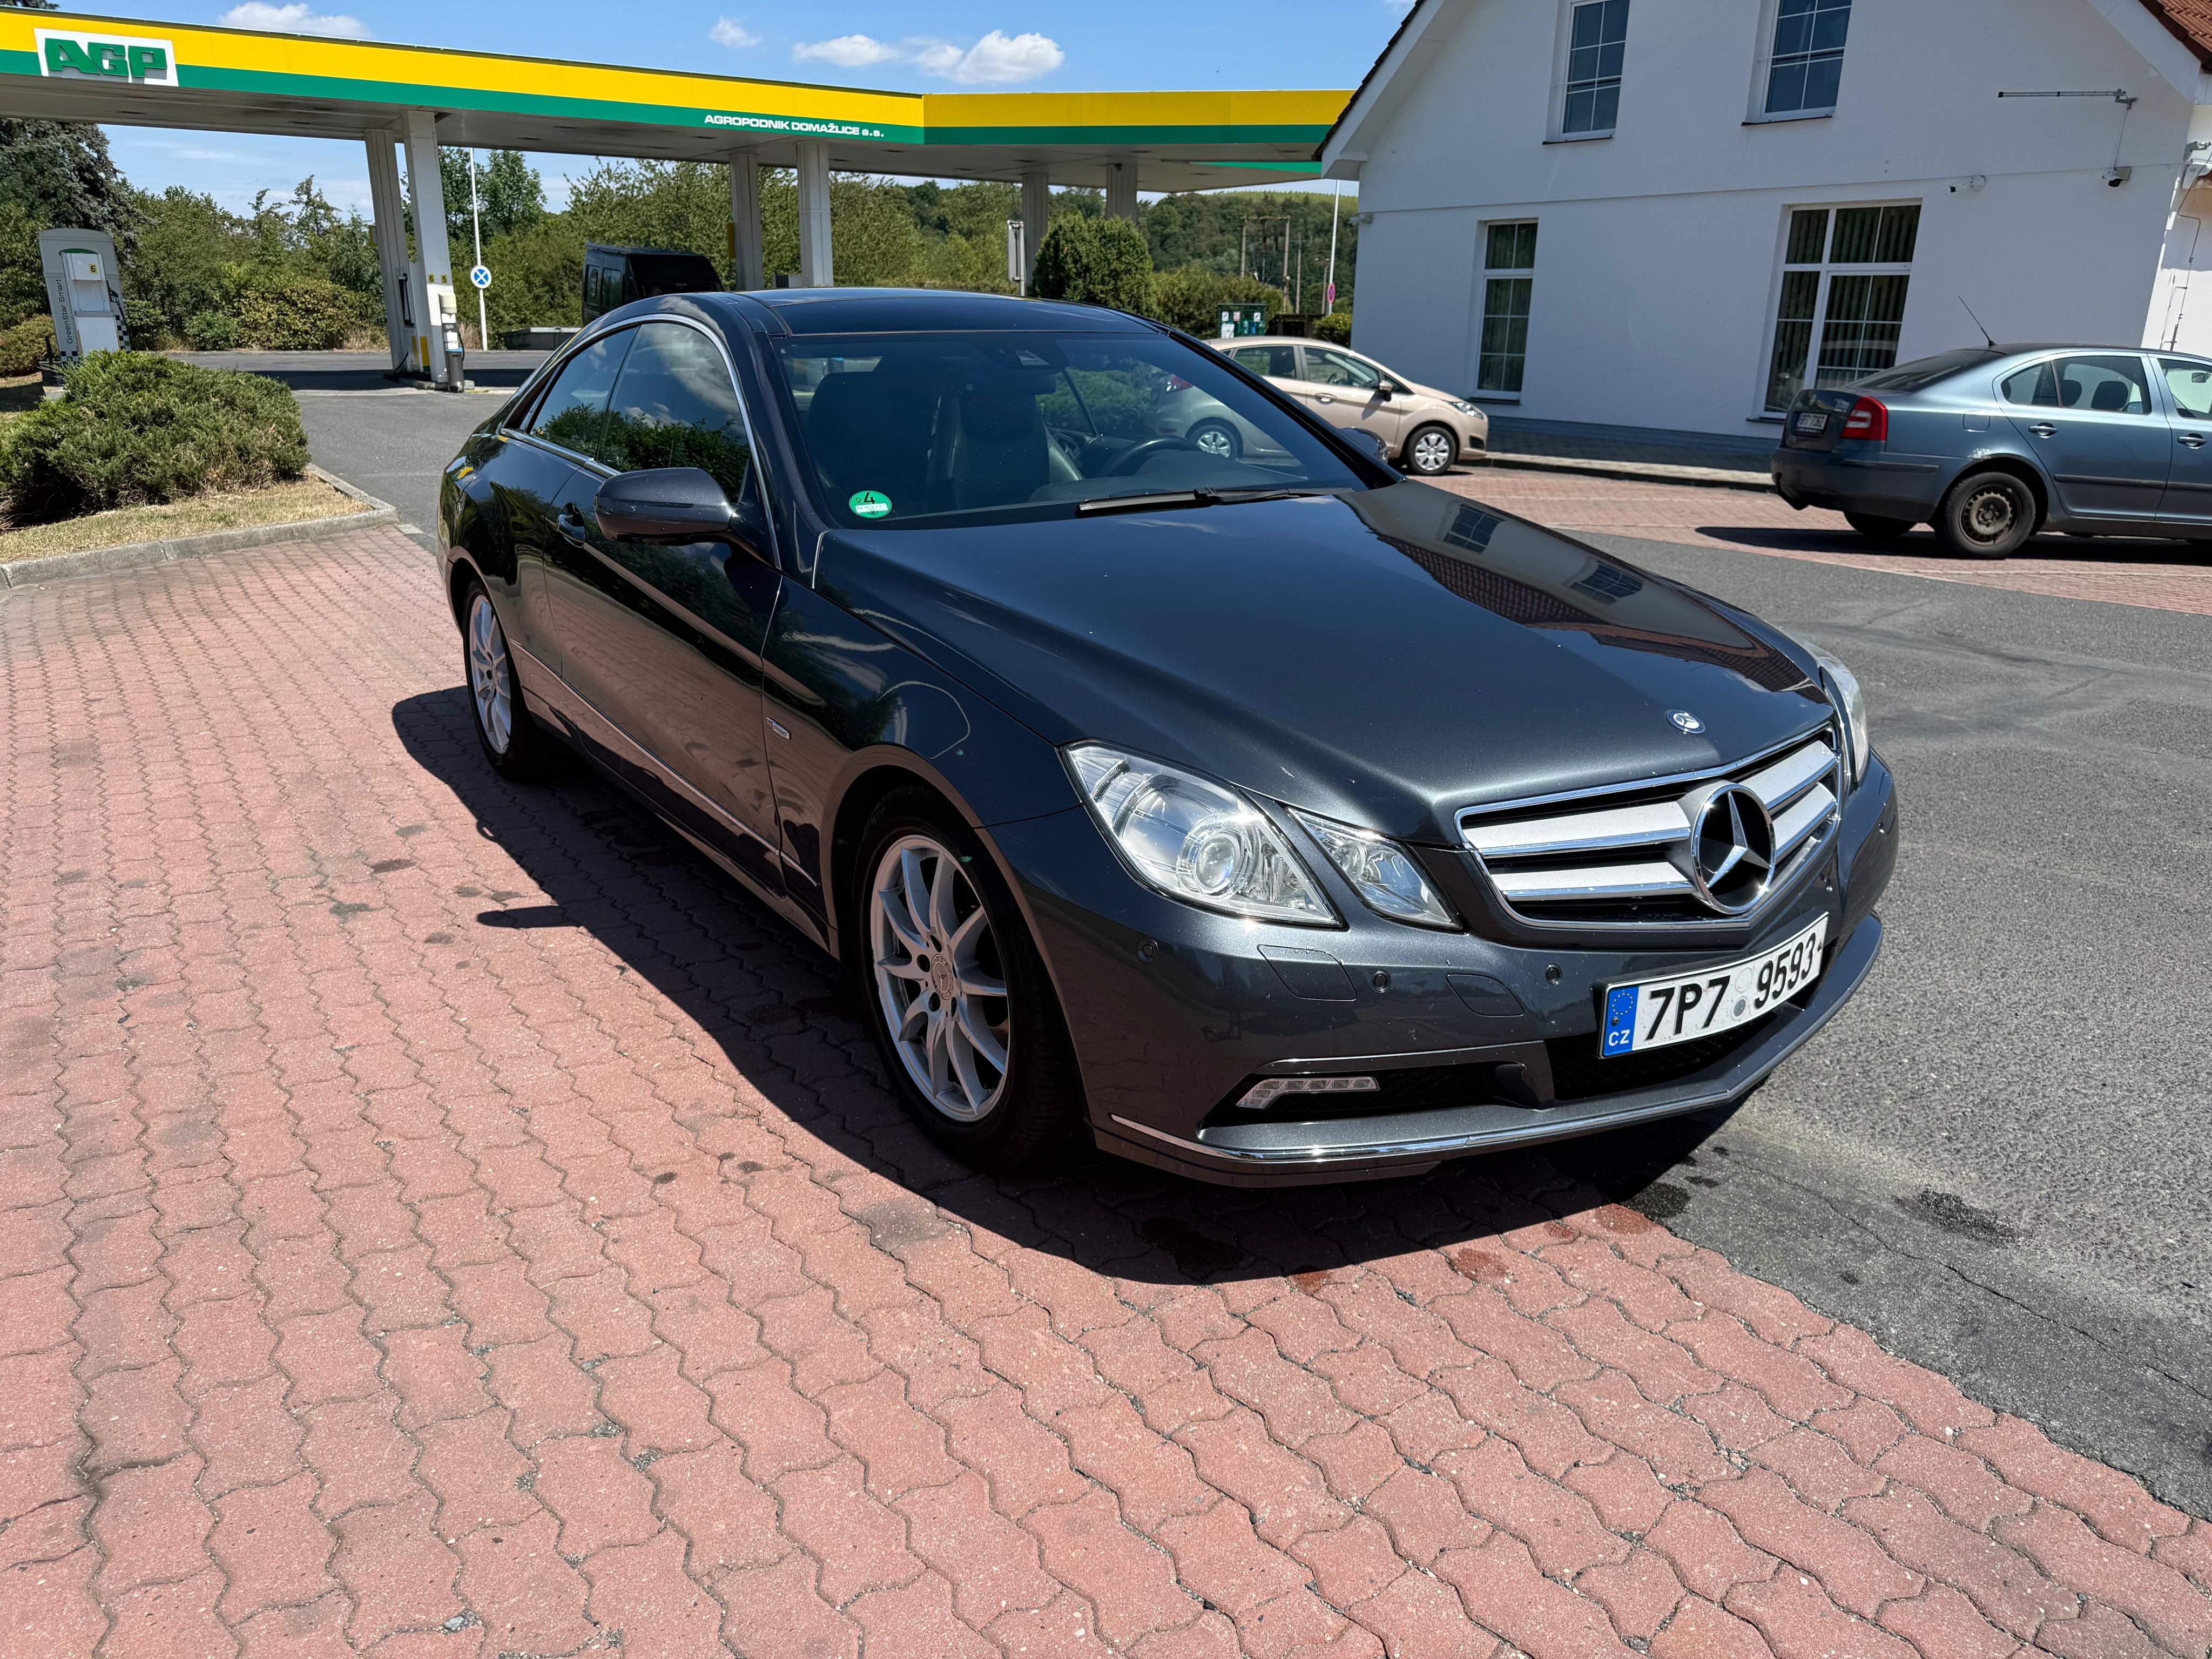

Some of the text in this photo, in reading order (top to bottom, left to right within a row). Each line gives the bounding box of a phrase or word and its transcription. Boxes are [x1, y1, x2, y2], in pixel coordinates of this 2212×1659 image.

[45, 38, 167, 78] AGP
[704, 114, 885, 137] AGROPODNIK DOMAŽLICE a.s.
[90, 265, 96, 273] 6
[56, 279, 73, 345] GreenStar Smart
[864, 492, 876, 504] 4
[1645, 932, 1816, 1041] 7P7 9593
[1608, 1029, 1630, 1047] CZ
